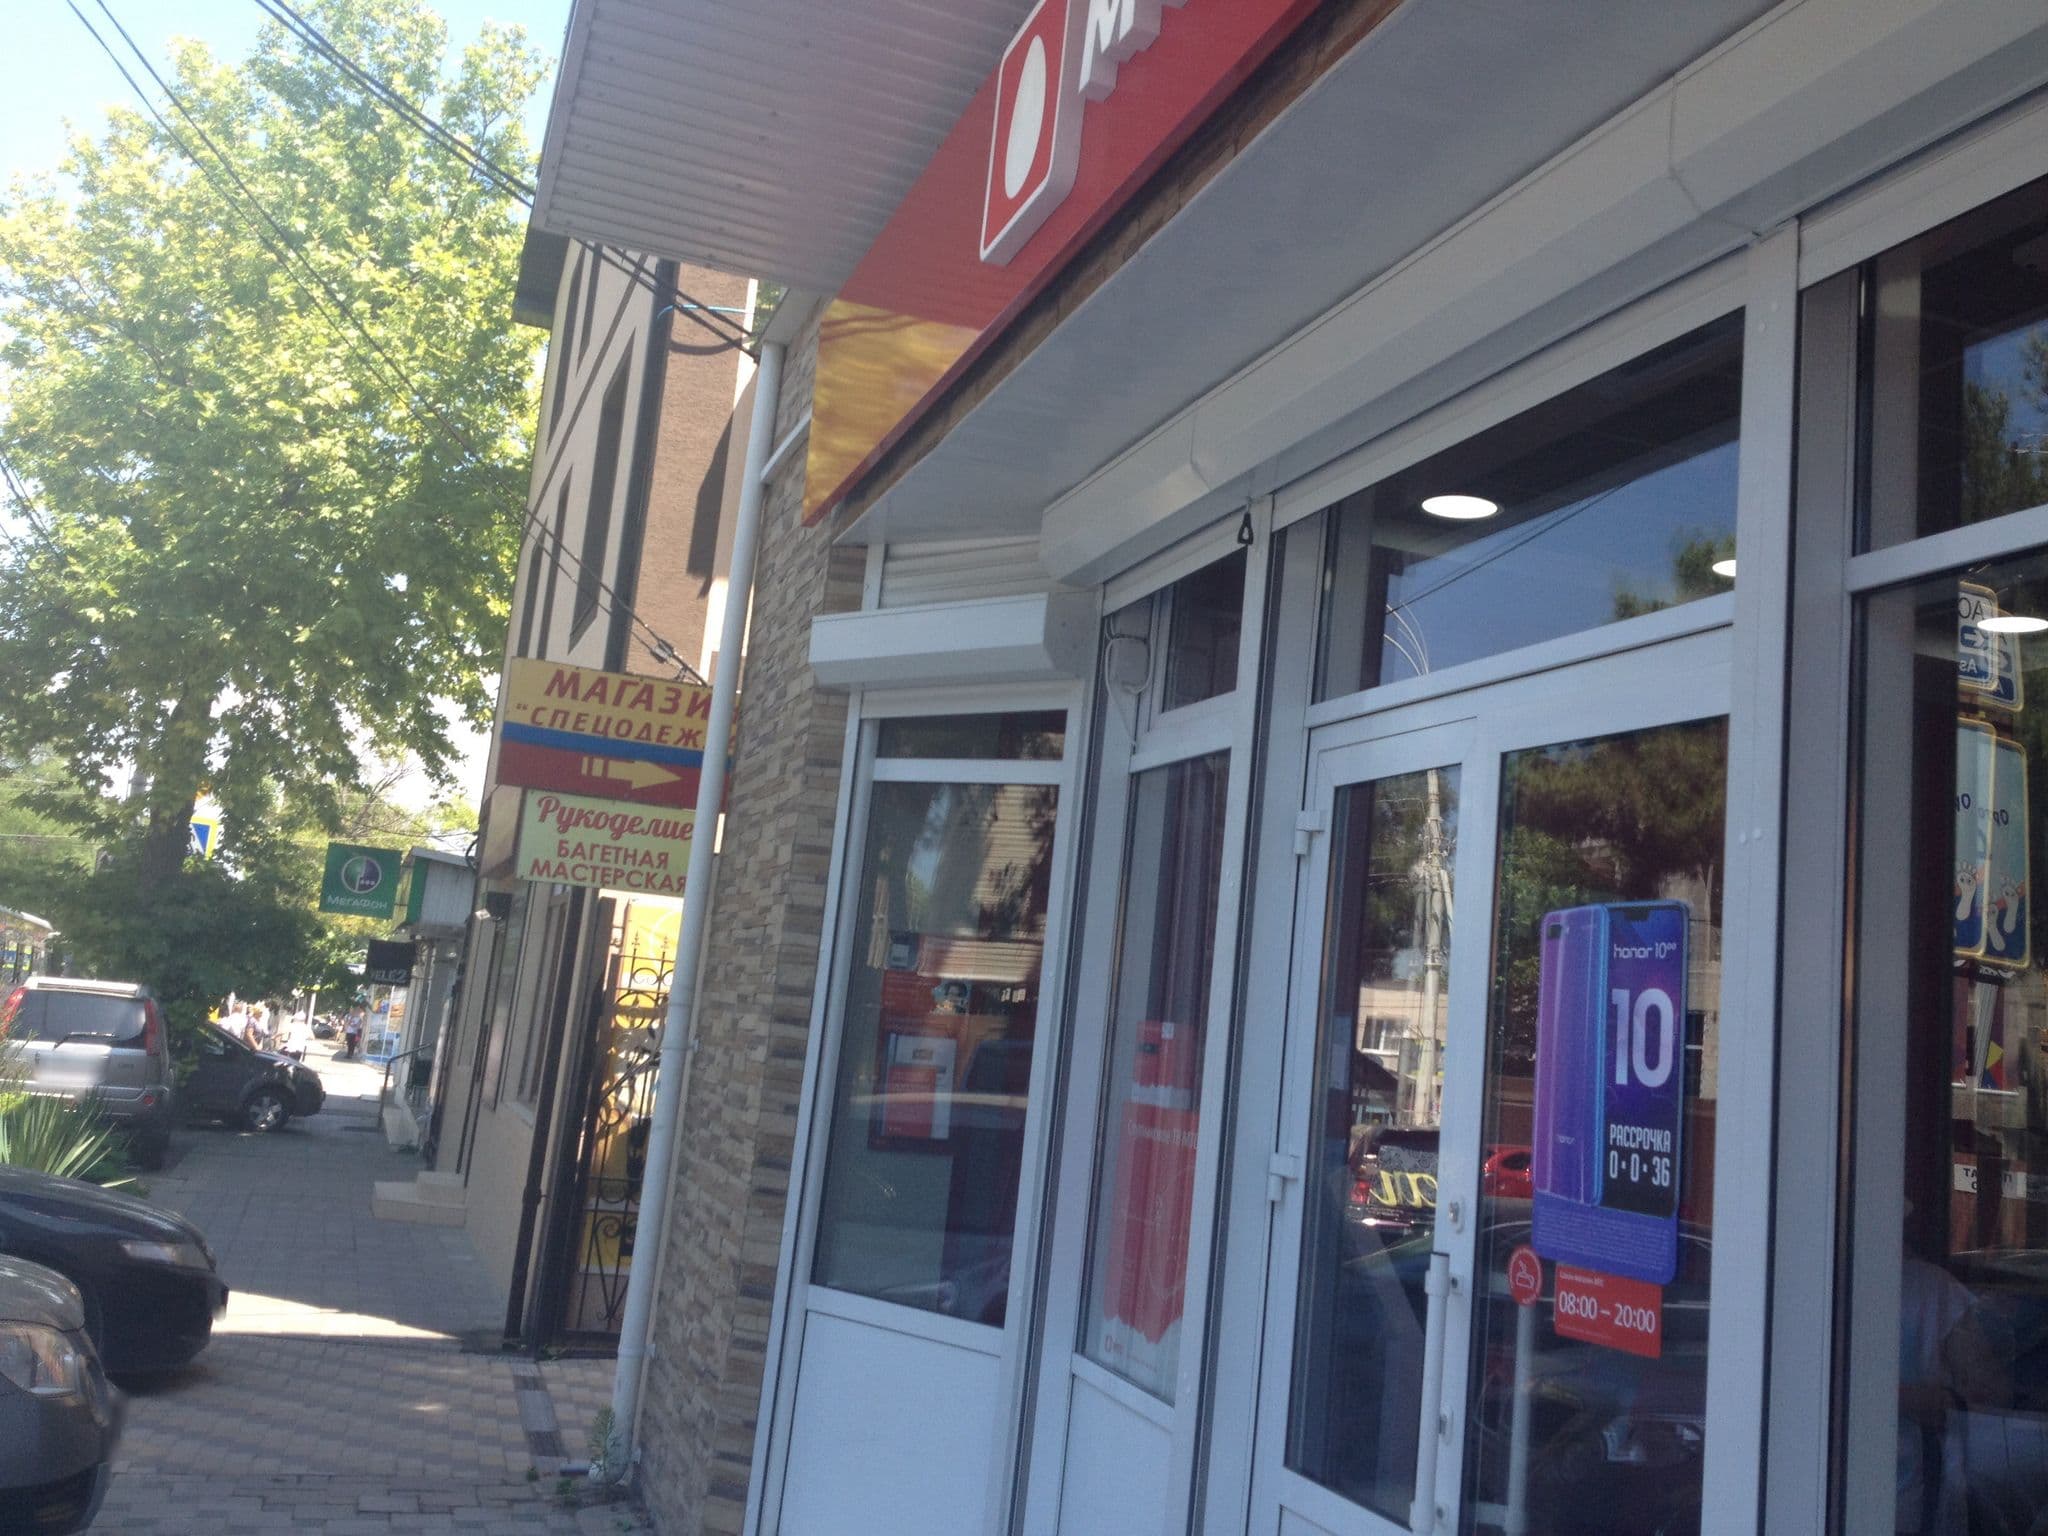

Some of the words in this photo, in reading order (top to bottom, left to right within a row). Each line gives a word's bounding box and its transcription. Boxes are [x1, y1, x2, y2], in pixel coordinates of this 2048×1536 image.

[544, 668, 713, 722] МАГАЗИ
[537, 796, 694, 841] Рукоделие
[529, 858, 688, 893] МАСТЕРСКАЯ
[557, 839, 670, 871] БАГЕТНАЯ
[1612, 988, 1674, 1088] 10
[1609, 1124, 1671, 1154] РАССРОЧКА
[1559, 1291, 1598, 1320] 08:00
[1614, 1303, 1656, 1334] 20:00
